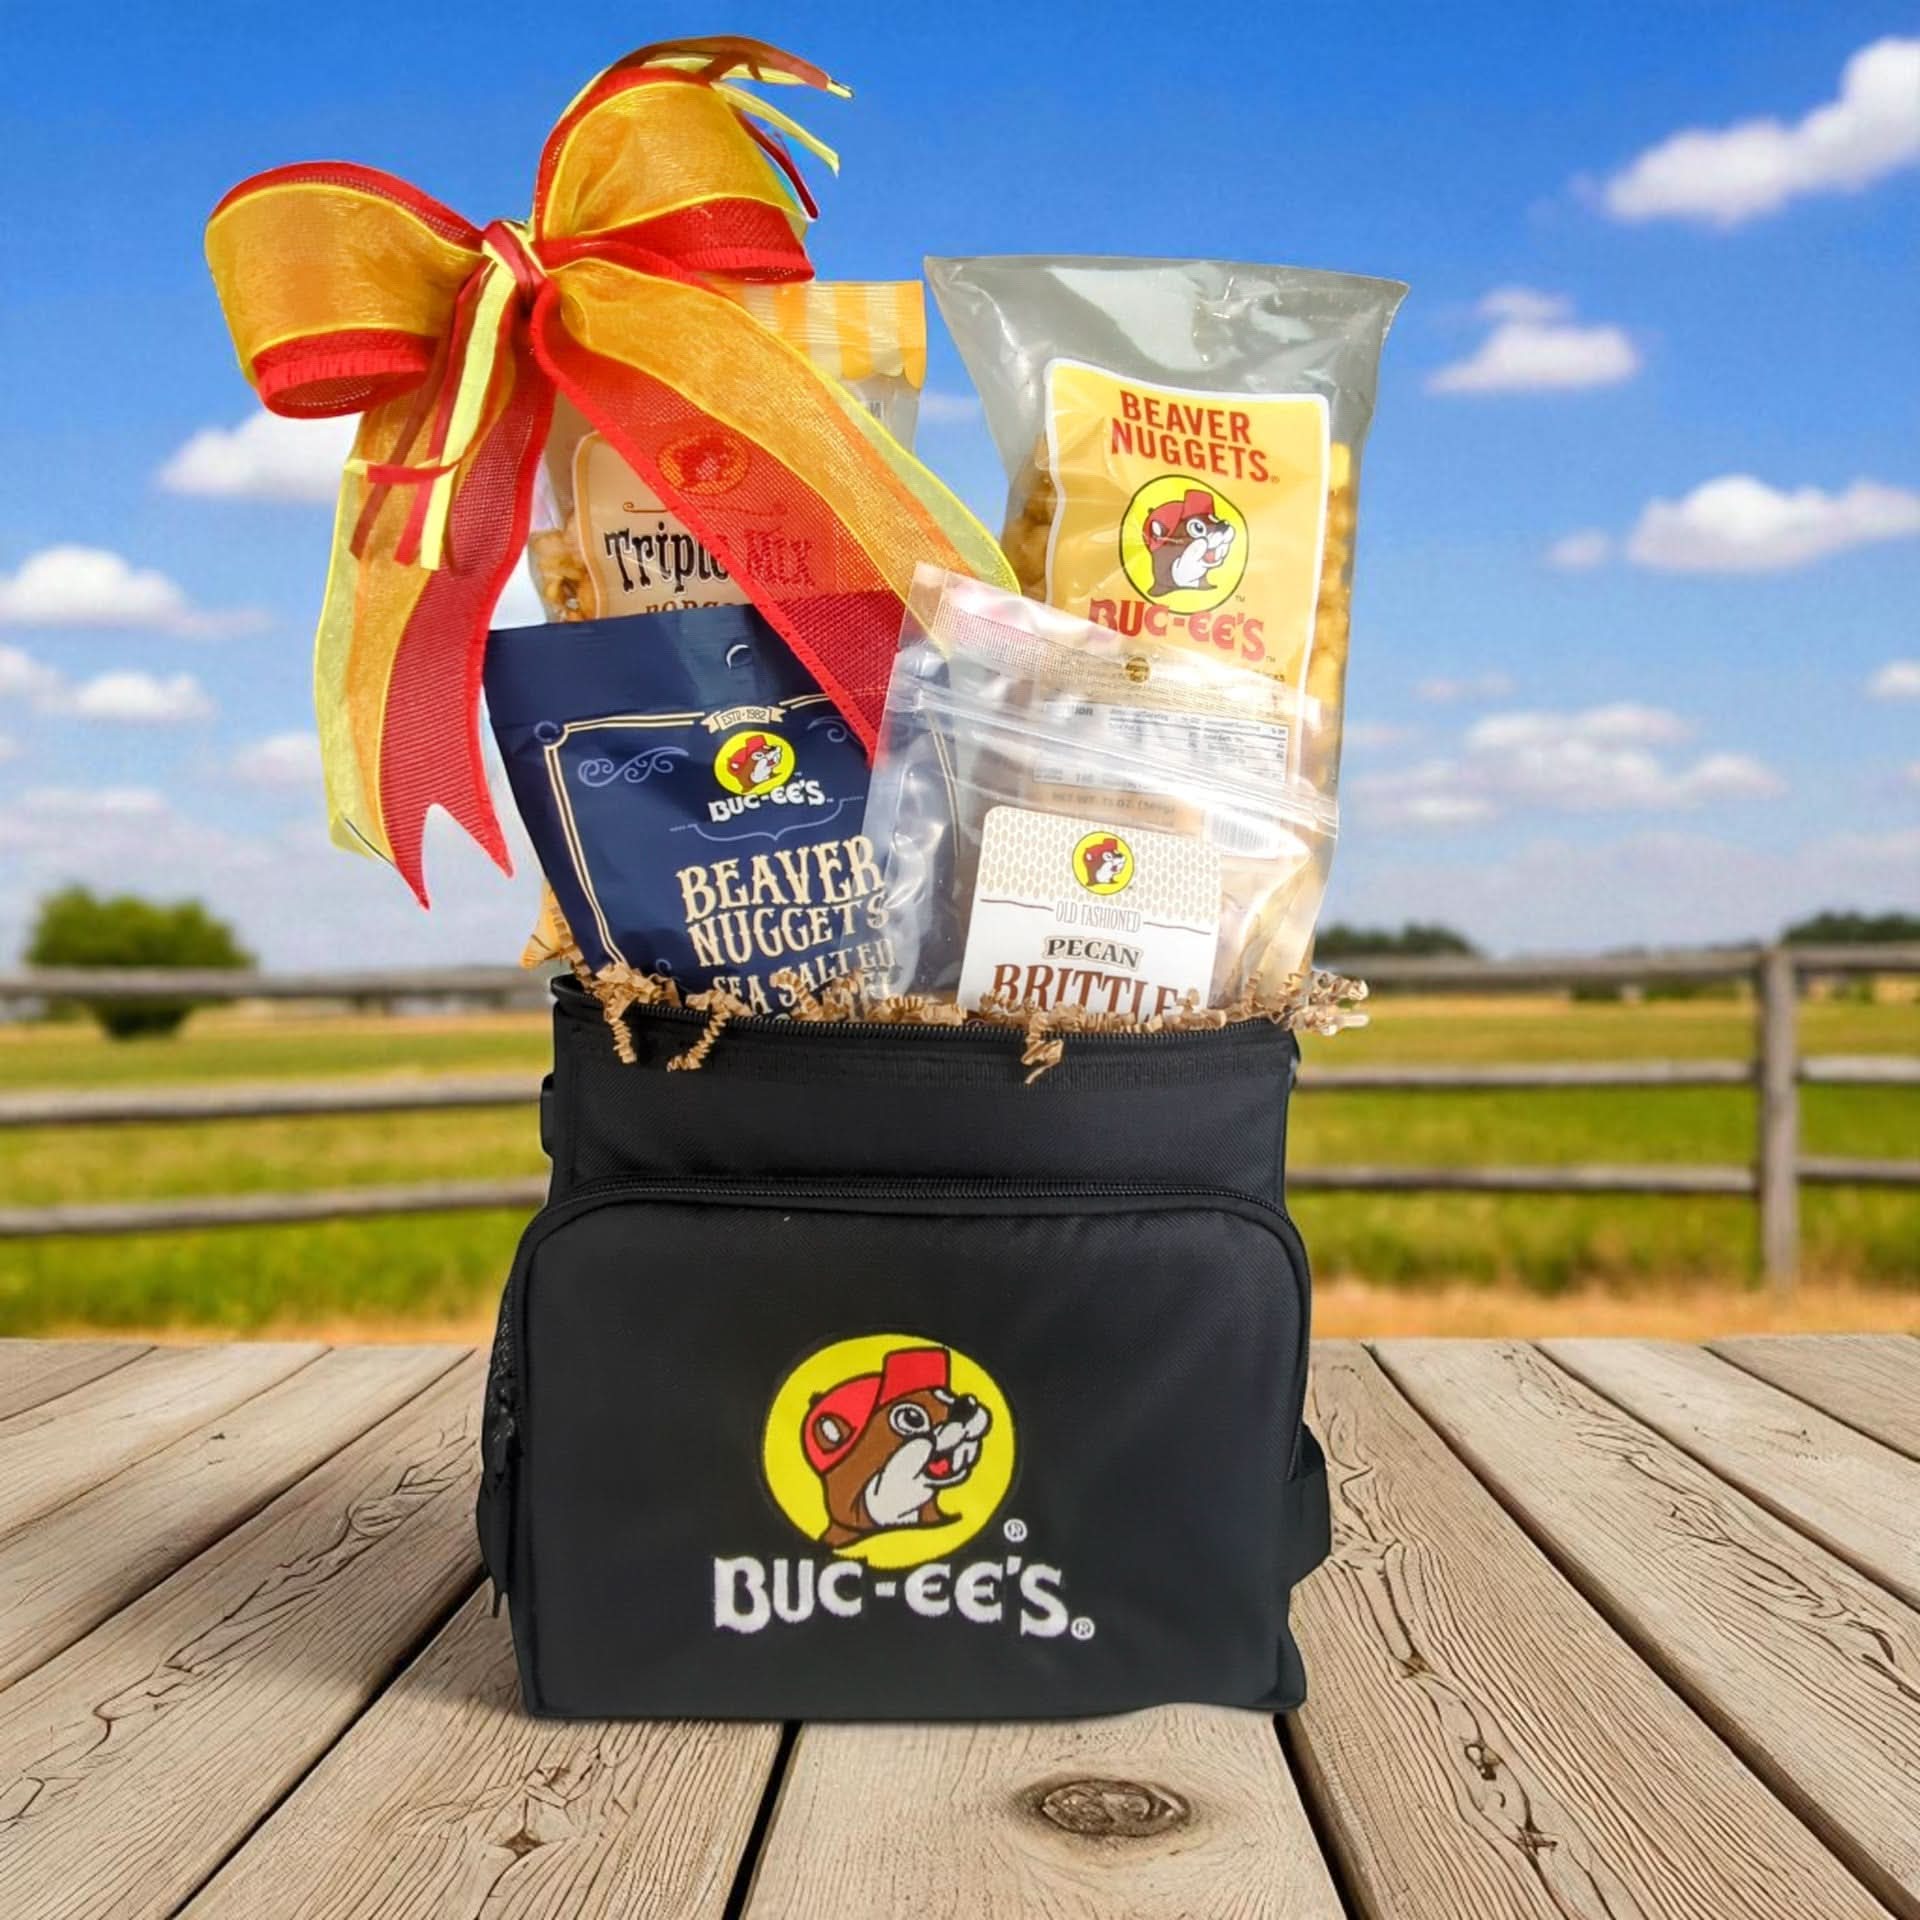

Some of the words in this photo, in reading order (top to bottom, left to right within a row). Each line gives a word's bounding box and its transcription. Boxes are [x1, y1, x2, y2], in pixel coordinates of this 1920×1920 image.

[1119, 390, 1252, 446] BEAVER
[1110, 417, 1270, 483] NUGGETS
[676, 834, 886, 923] BEAVER
[687, 889, 891, 968] NUGGETS
[1055, 900, 1079, 924] OLD
[1080, 904, 1141, 933] FASHIONED
[1046, 937, 1140, 969] PECAN
[992, 963, 1180, 1023] BRITTLE
[713, 1555, 1070, 1640] BUC-EE'S
